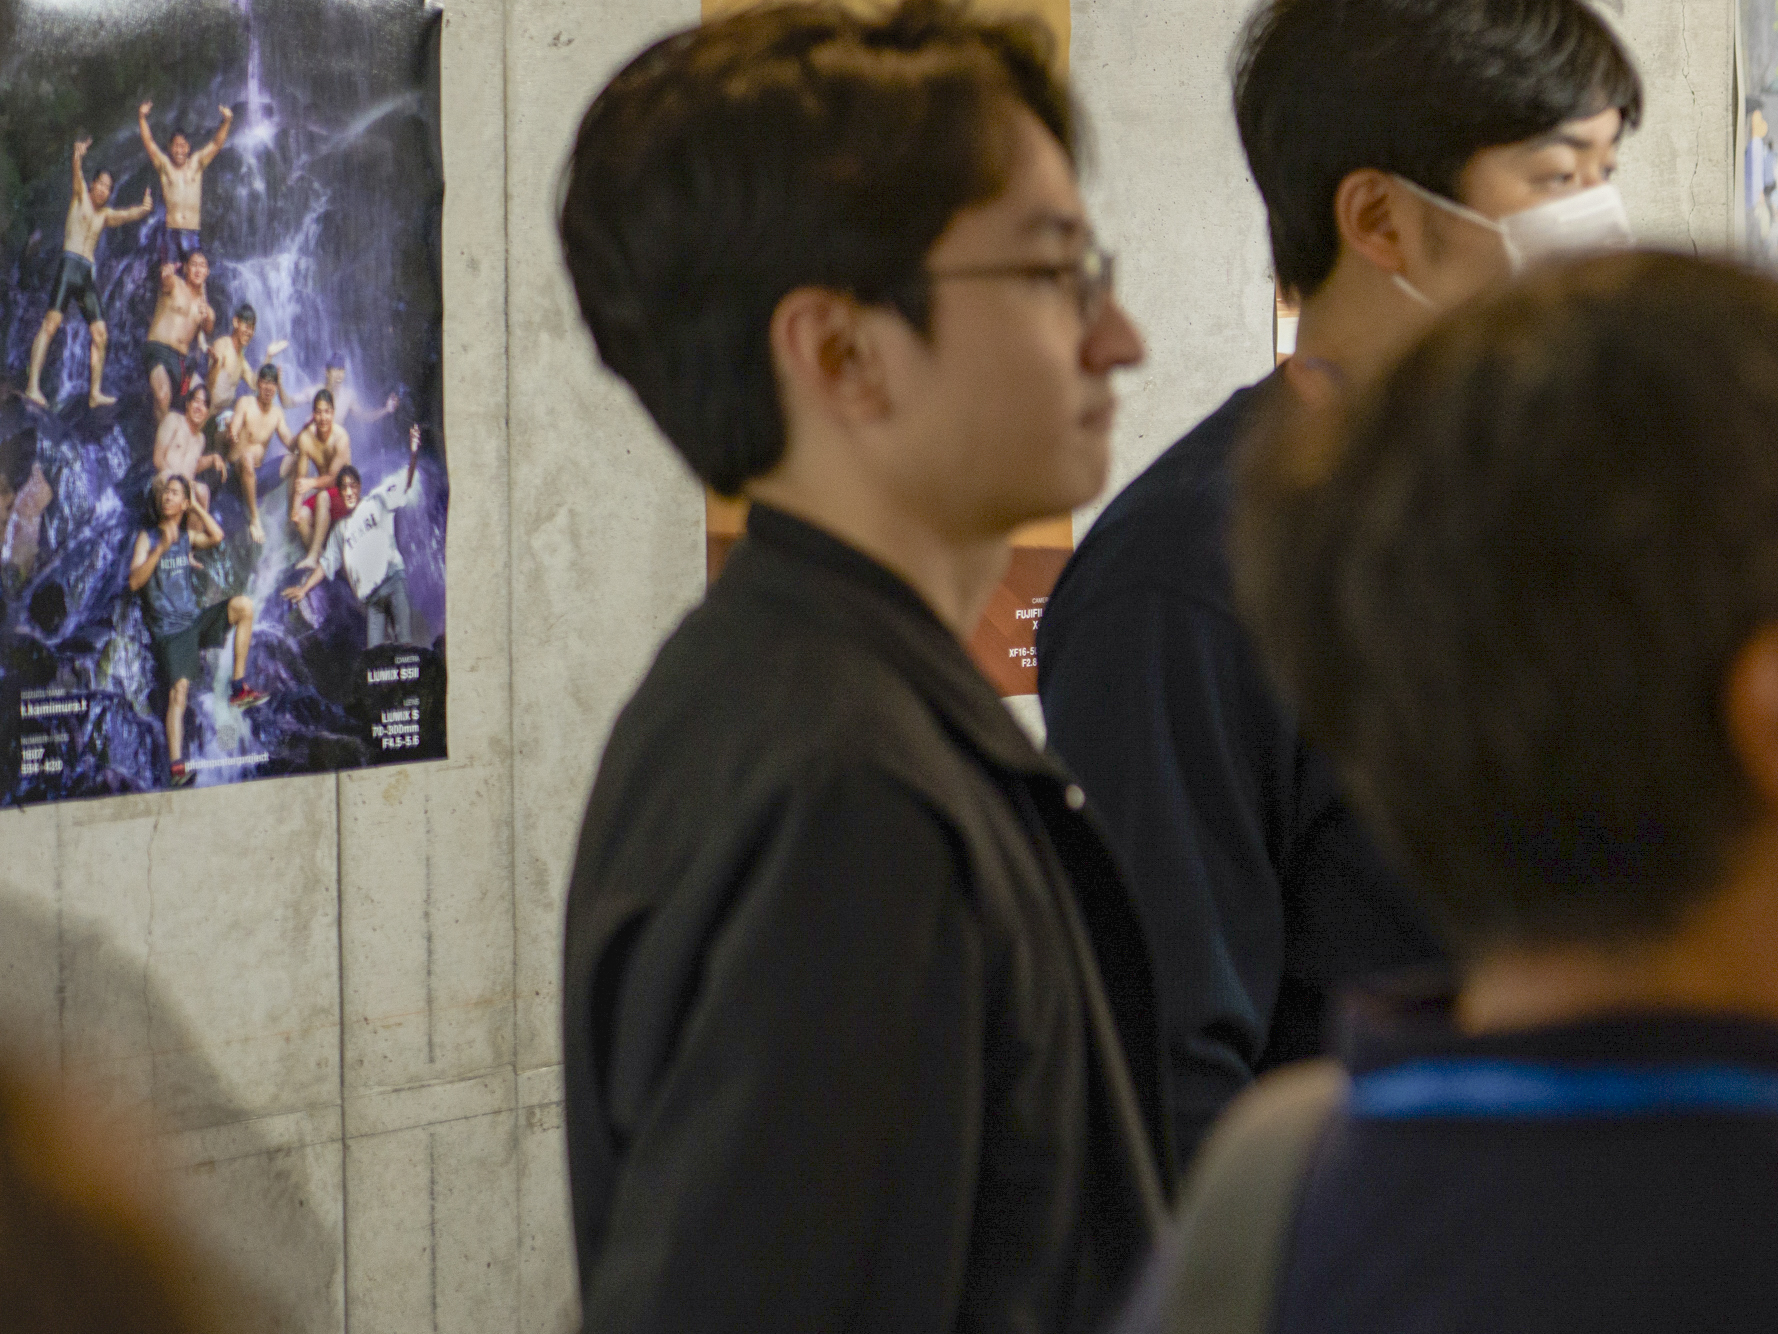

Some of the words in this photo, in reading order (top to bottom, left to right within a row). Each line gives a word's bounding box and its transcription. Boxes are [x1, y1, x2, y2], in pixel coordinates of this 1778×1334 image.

[1022, 658, 1038, 668] F2.8
[367, 668, 399, 683] LUMIX
[381, 710, 411, 723] LUMIX
[411, 709, 420, 720] S
